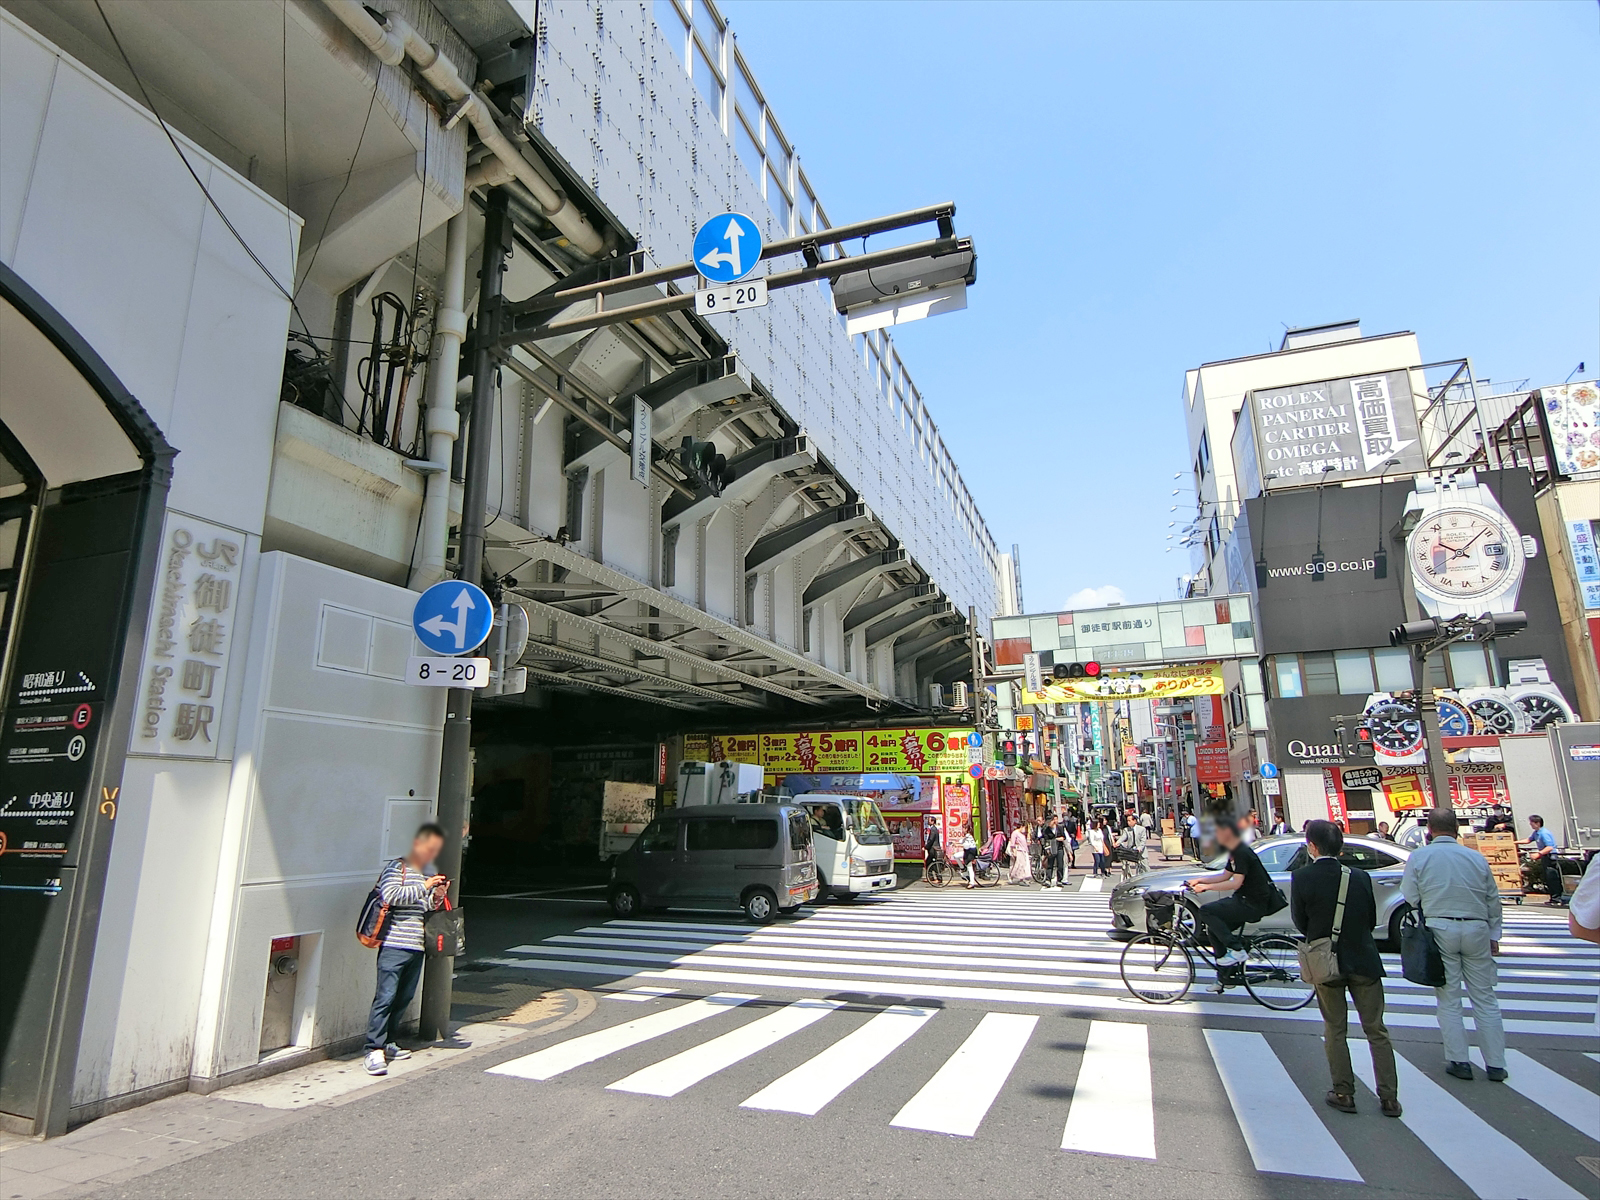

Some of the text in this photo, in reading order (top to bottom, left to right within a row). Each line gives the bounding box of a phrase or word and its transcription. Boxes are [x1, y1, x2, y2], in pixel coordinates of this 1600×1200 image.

[1259, 389, 1326, 411] ROLEX
[1262, 404, 1347, 427] PANERAI
[1355, 379, 1394, 456] 高価買取
[1265, 421, 1352, 444] CARTIER
[1267, 440, 1341, 461] OMEGA
[1270, 455, 1358, 478] etc 高級時計
[197, 538, 239, 566] JR
[1573, 523, 1595, 575] 隆盛不動産
[1268, 558, 1375, 578] www.909.co.jp
[142, 528, 193, 738] Okachimachi Station
[1081, 618, 1152, 634] 御徒町駅前通り
[174, 572, 232, 742] 御徒町駅
[22, 670, 66, 689] 昭和通り
[1153, 667, 1213, 678] みんなに笑顔を
[1155, 676, 1214, 691] ありがとう
[78, 710, 87, 722] E
[1018, 717, 1031, 729] 薬
[72, 742, 81, 754] H
[727, 737, 757, 752] 2億円
[819, 733, 858, 752] 5億円
[866, 735, 897, 748] 4億円
[869, 753, 897, 765] 2億円
[1299, 757, 1346, 765] www.909.co.jp
[1345, 769, 1378, 780] 最短5分の
[1346, 776, 1380, 787] 無料査定!
[29, 791, 74, 809] 中央通り
